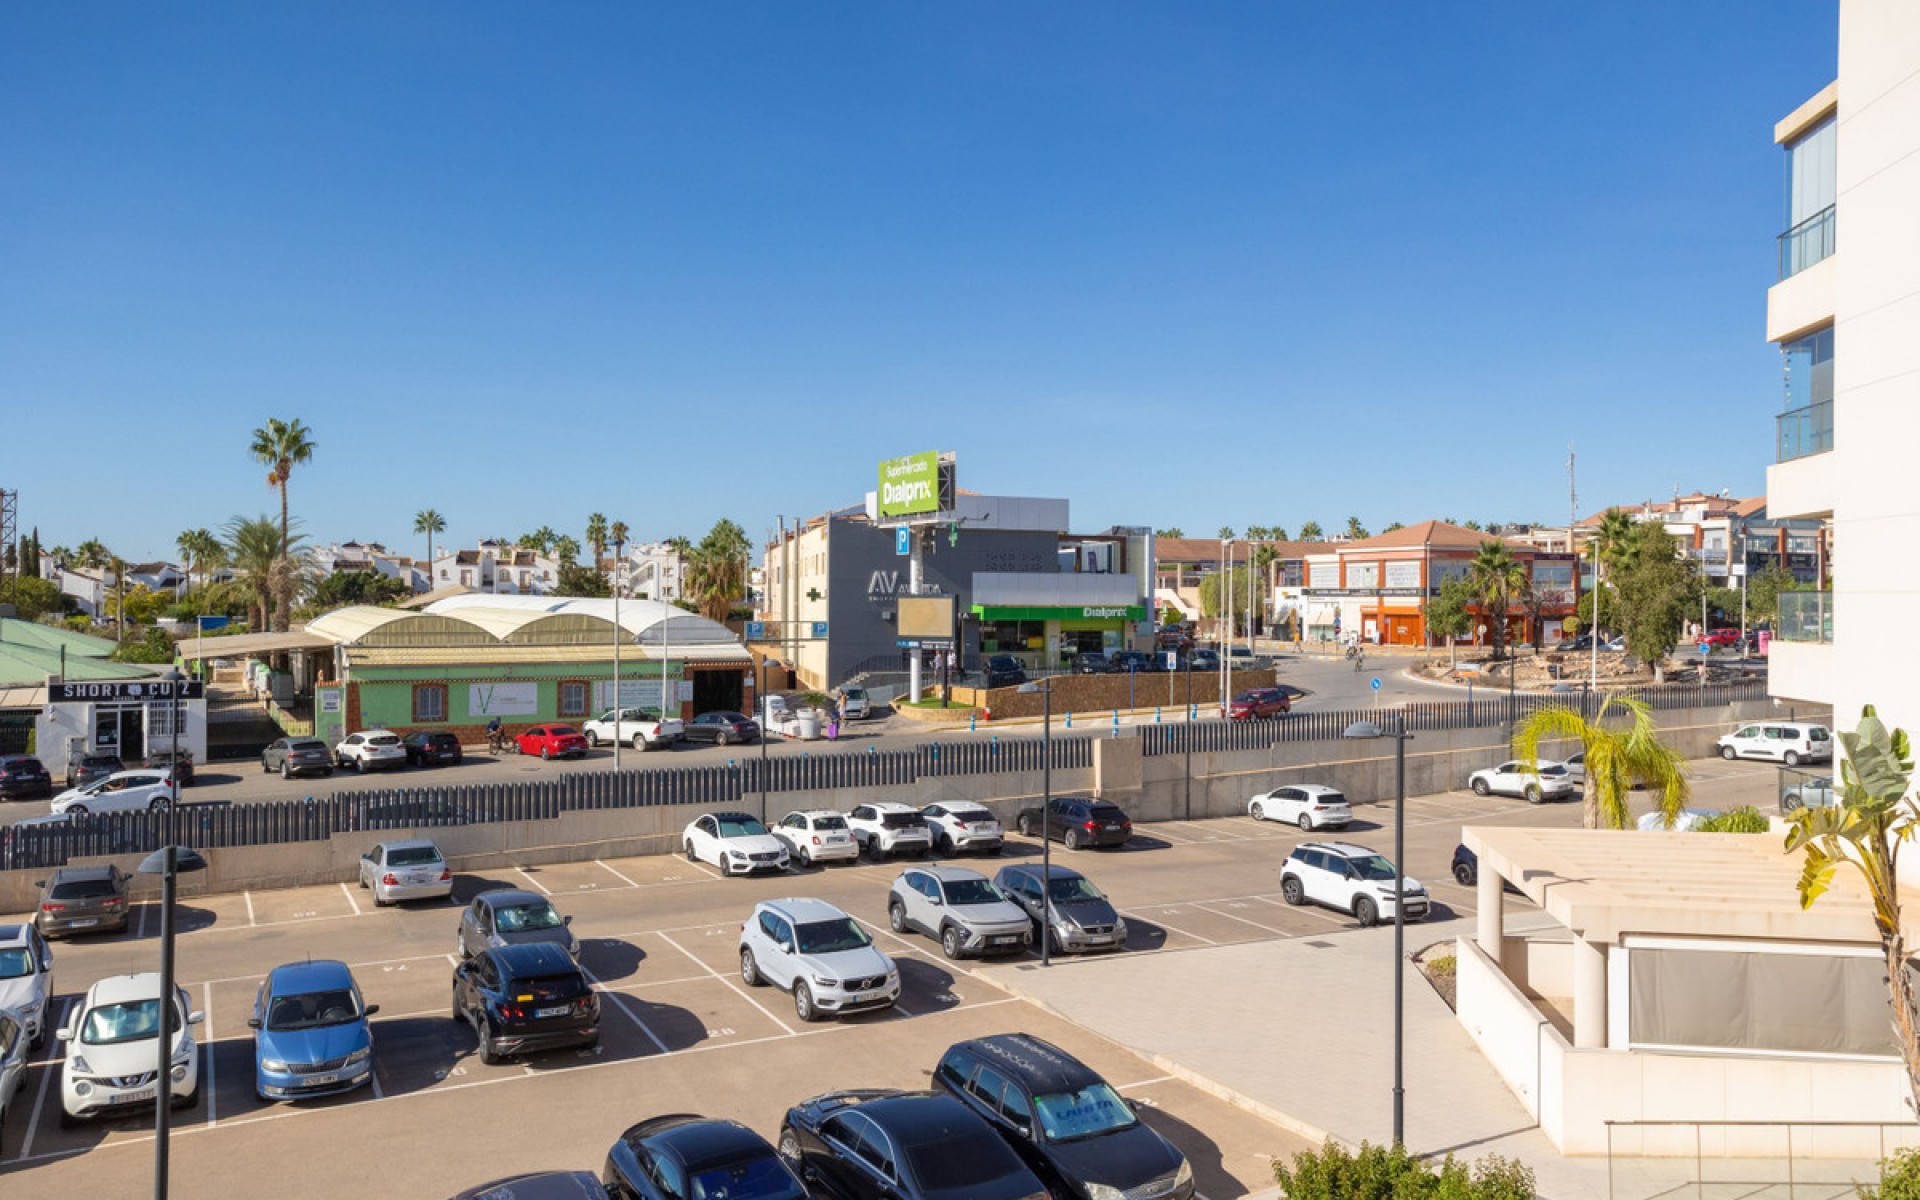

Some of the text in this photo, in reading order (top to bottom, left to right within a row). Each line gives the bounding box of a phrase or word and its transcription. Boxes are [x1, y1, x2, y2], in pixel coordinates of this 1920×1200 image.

[899, 531, 906, 550] P
[868, 570, 898, 593] AV
[64, 682, 189, 697] SHORT CUZ
